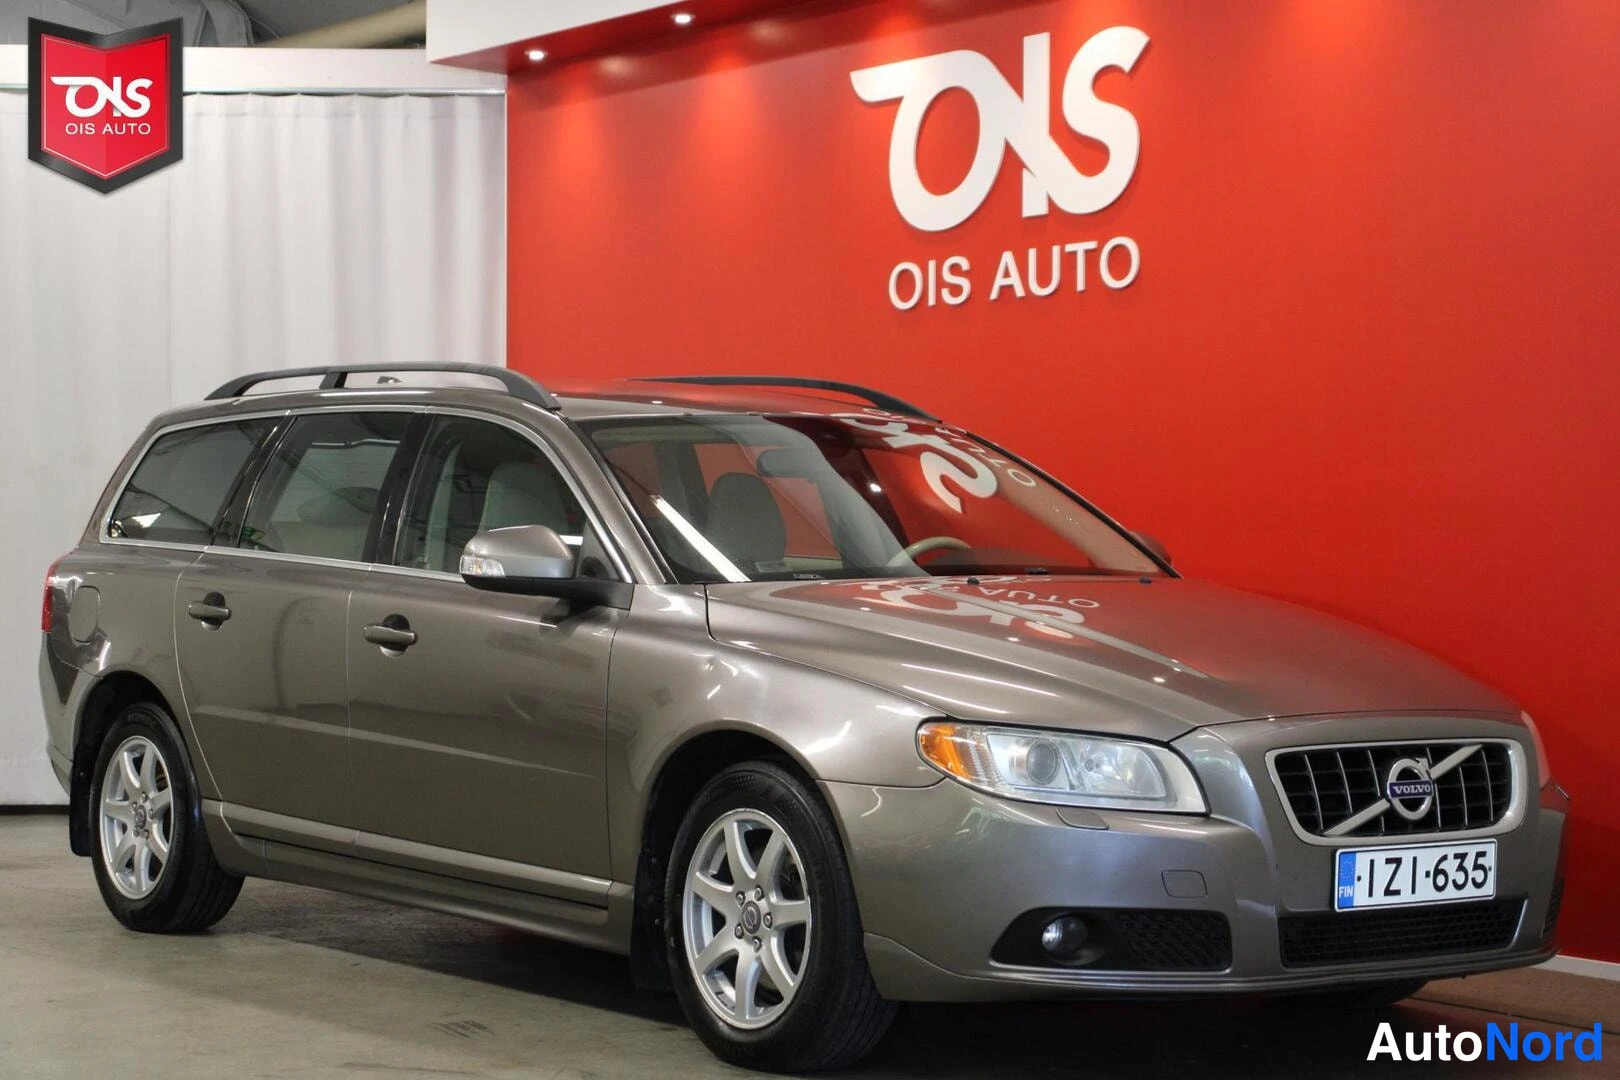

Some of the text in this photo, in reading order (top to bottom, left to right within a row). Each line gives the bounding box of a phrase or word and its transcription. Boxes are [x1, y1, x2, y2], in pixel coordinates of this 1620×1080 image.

[888, 236, 1140, 310] OIS AUTO
[1392, 784, 1431, 794] VOLVO
[1338, 885, 1354, 898] FIN
